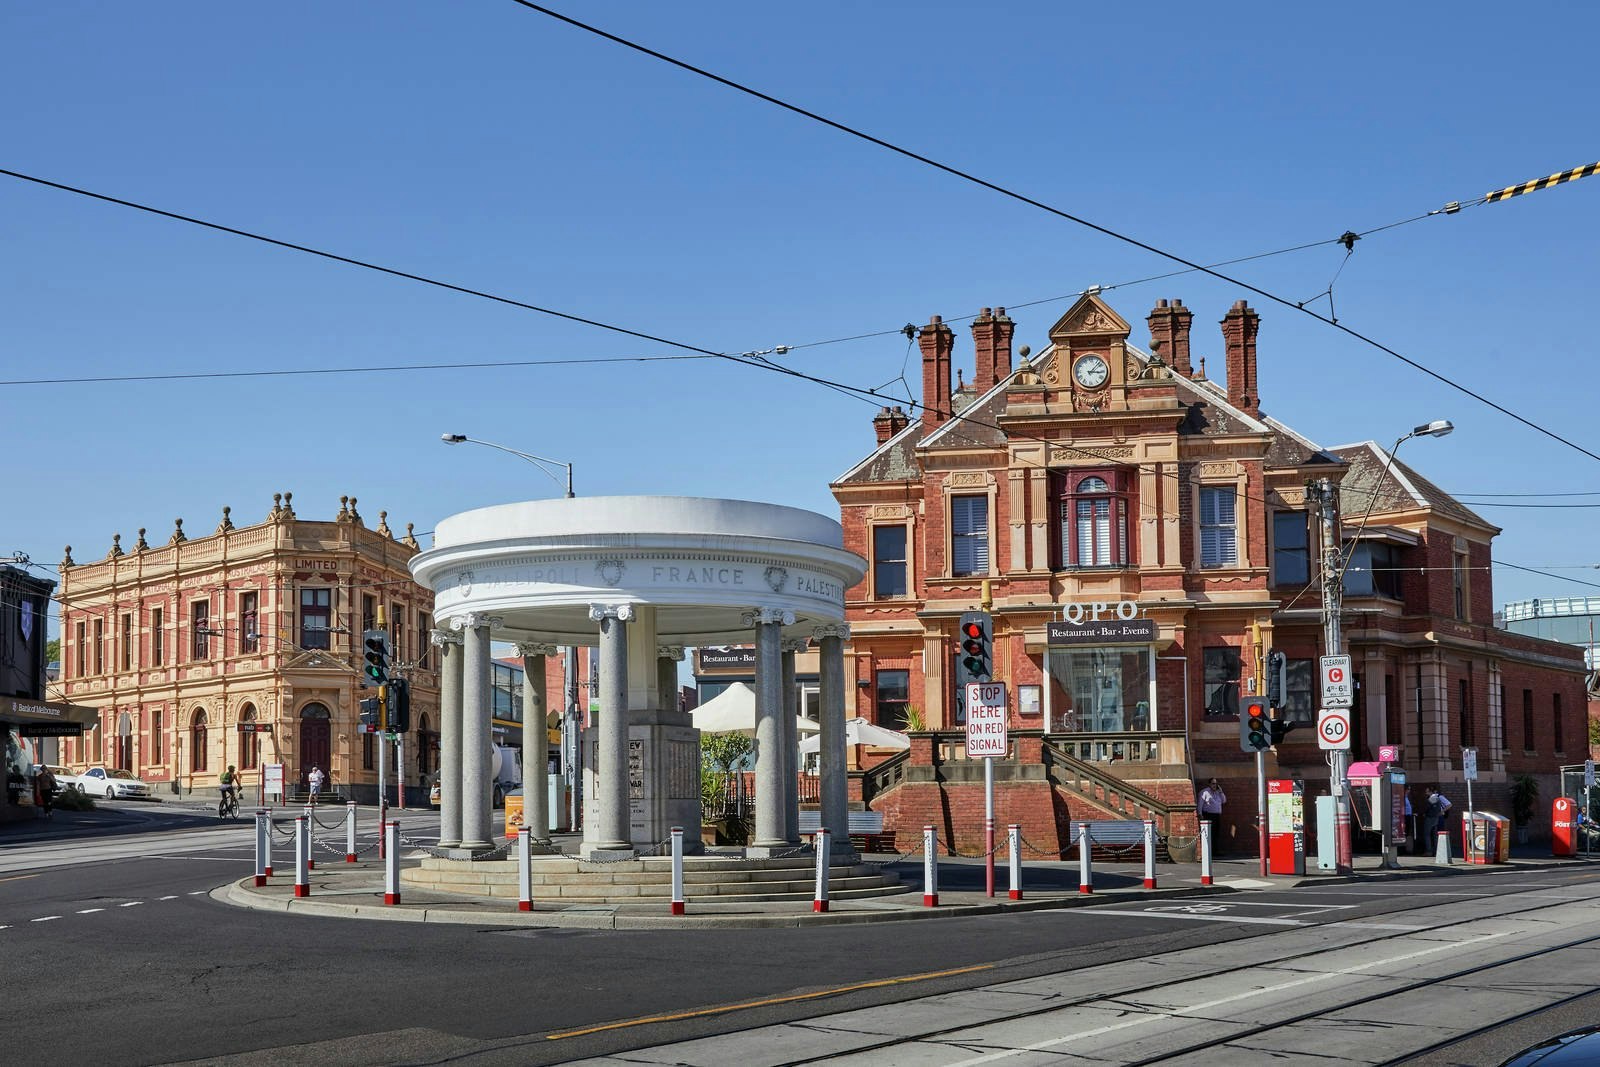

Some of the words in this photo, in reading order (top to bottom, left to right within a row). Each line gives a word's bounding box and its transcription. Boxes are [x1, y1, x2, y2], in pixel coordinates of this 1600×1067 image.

[295, 559, 337, 570] LIMITED
[652, 566, 744, 585] FRANCE
[184, 577, 201, 587] BANK
[1052, 628, 1095, 637] Restaurant
[1101, 627, 1118, 636] Bar
[1122, 625, 1149, 635] Events
[703, 655, 739, 663] Restaurant
[743, 654, 756, 662] Bar
[1324, 659, 1347, 667] CLEARWAY
[972, 687, 1001, 701] STOP
[972, 705, 1001, 718] HERE
[970, 723, 983, 734] ON
[985, 722, 1004, 733] RED
[1325, 723, 1344, 735] 60
[970, 739, 1004, 750] SIGNAL
